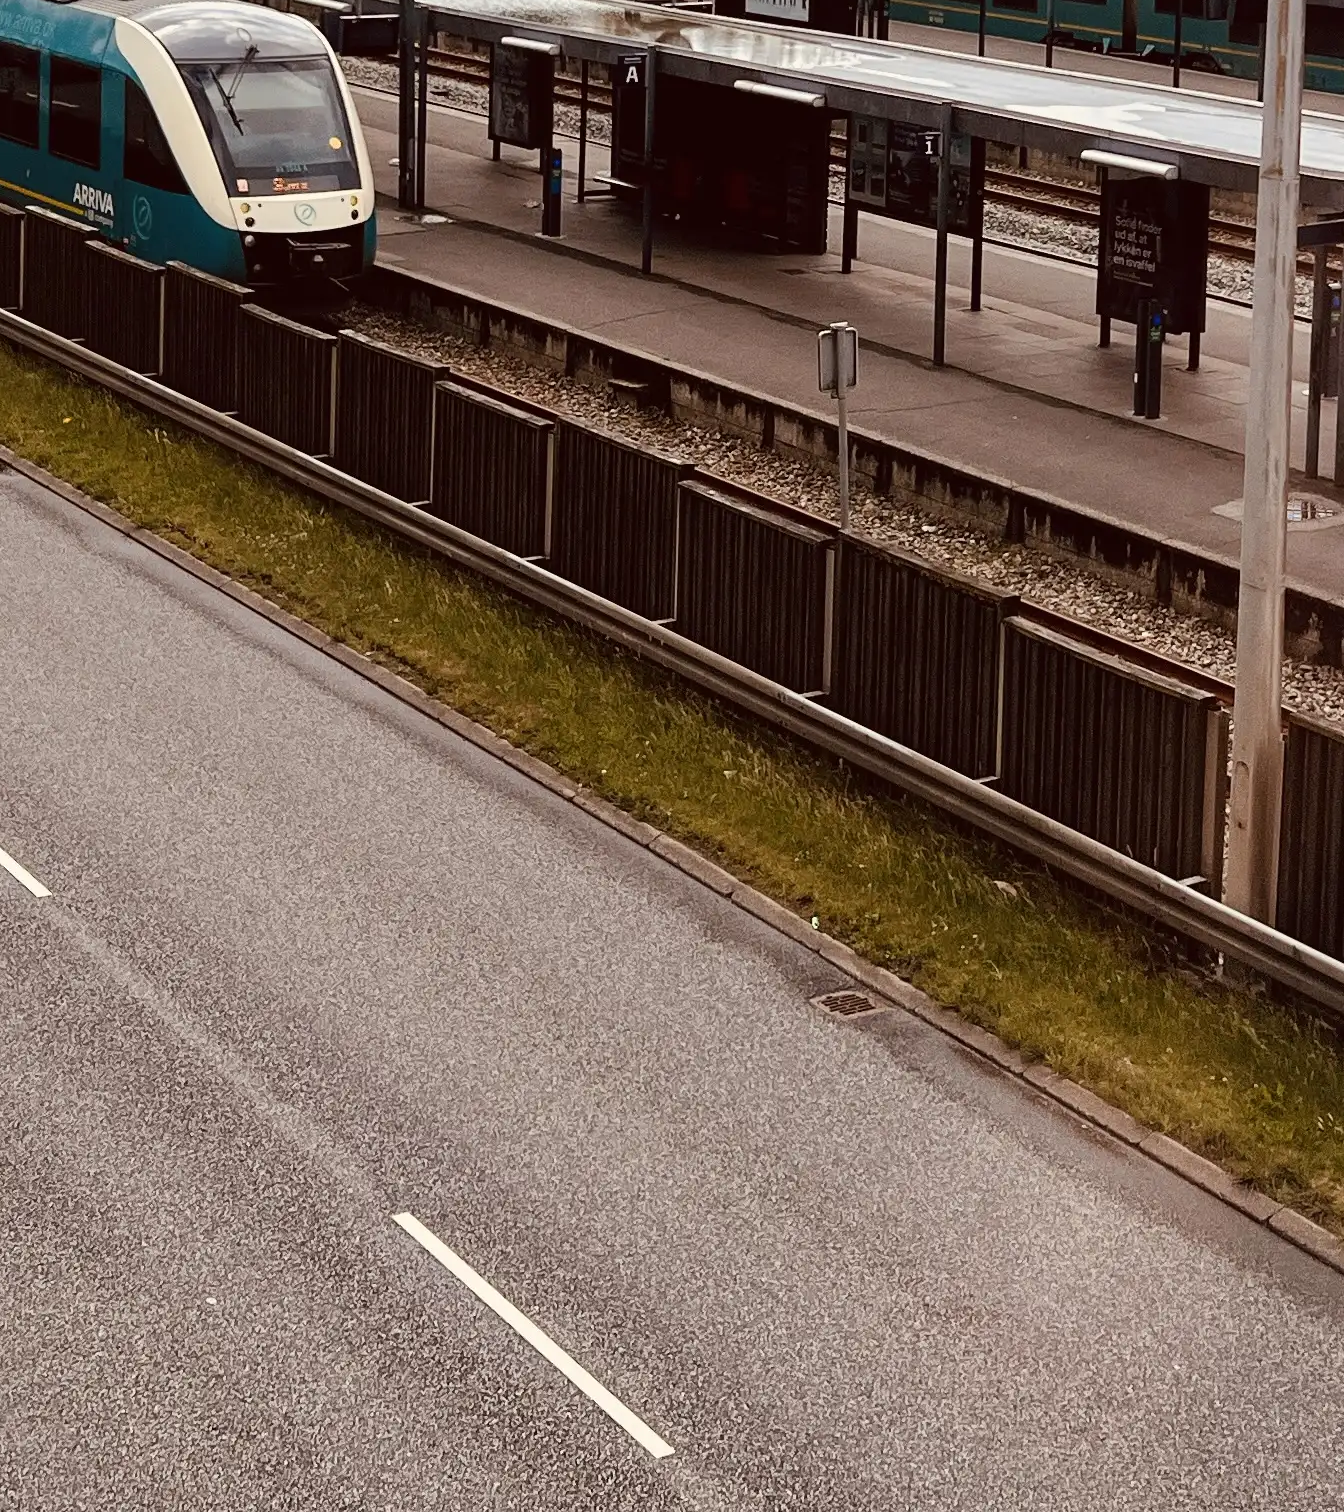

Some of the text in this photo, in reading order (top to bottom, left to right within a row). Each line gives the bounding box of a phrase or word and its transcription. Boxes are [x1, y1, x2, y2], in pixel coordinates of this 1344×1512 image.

[625, 65, 639, 84] A
[924, 140, 934, 155] 1
[72, 182, 115, 217] ARRIVA
[1114, 229, 1127, 240] ud
[1138, 234, 1148, 245] at
[1113, 255, 1125, 266] en
[1142, 249, 1153, 259] er
